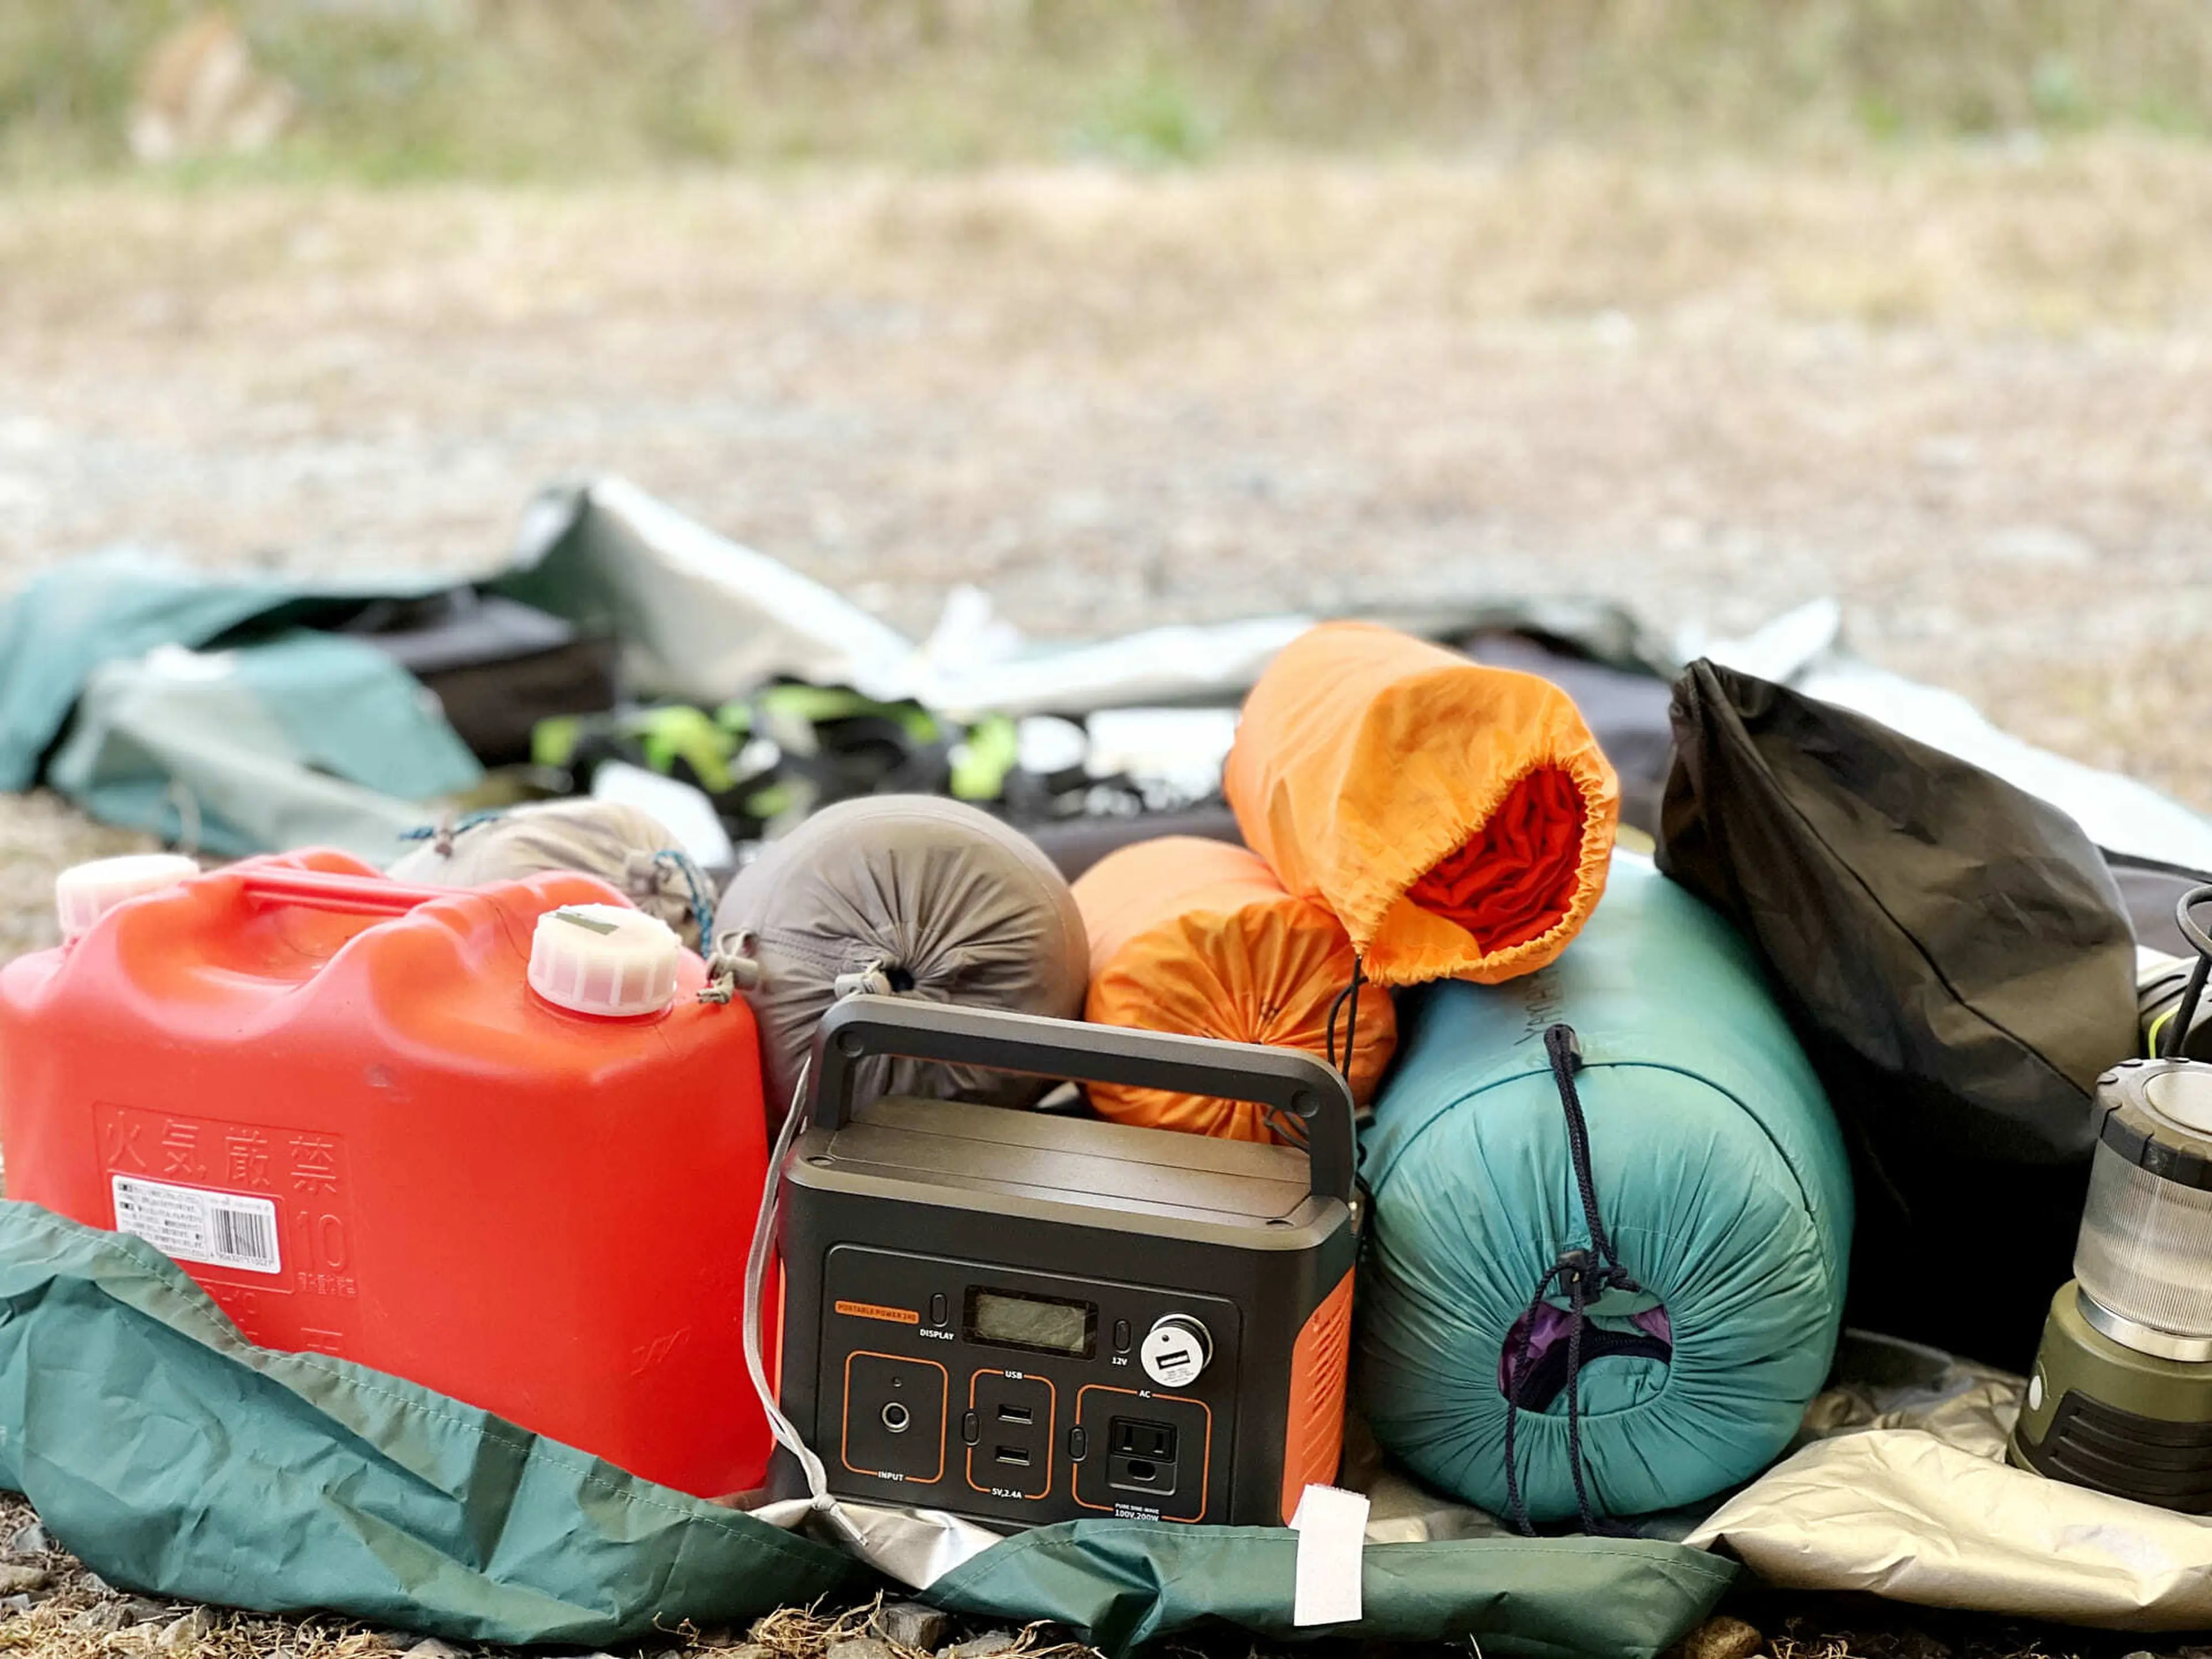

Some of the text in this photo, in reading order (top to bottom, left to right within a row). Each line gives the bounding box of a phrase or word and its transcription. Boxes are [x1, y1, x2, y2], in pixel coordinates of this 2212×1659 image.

[106, 1111, 338, 1194] 火気厳禁
[296, 1210, 346, 1268] 10
[919, 1328, 955, 1340] DISPLAY
[1111, 1357, 1127, 1366] 12V
[1005, 1370, 1022, 1379] USB
[1139, 1390, 1150, 1398] AC
[878, 1471, 904, 1482] INPUT
